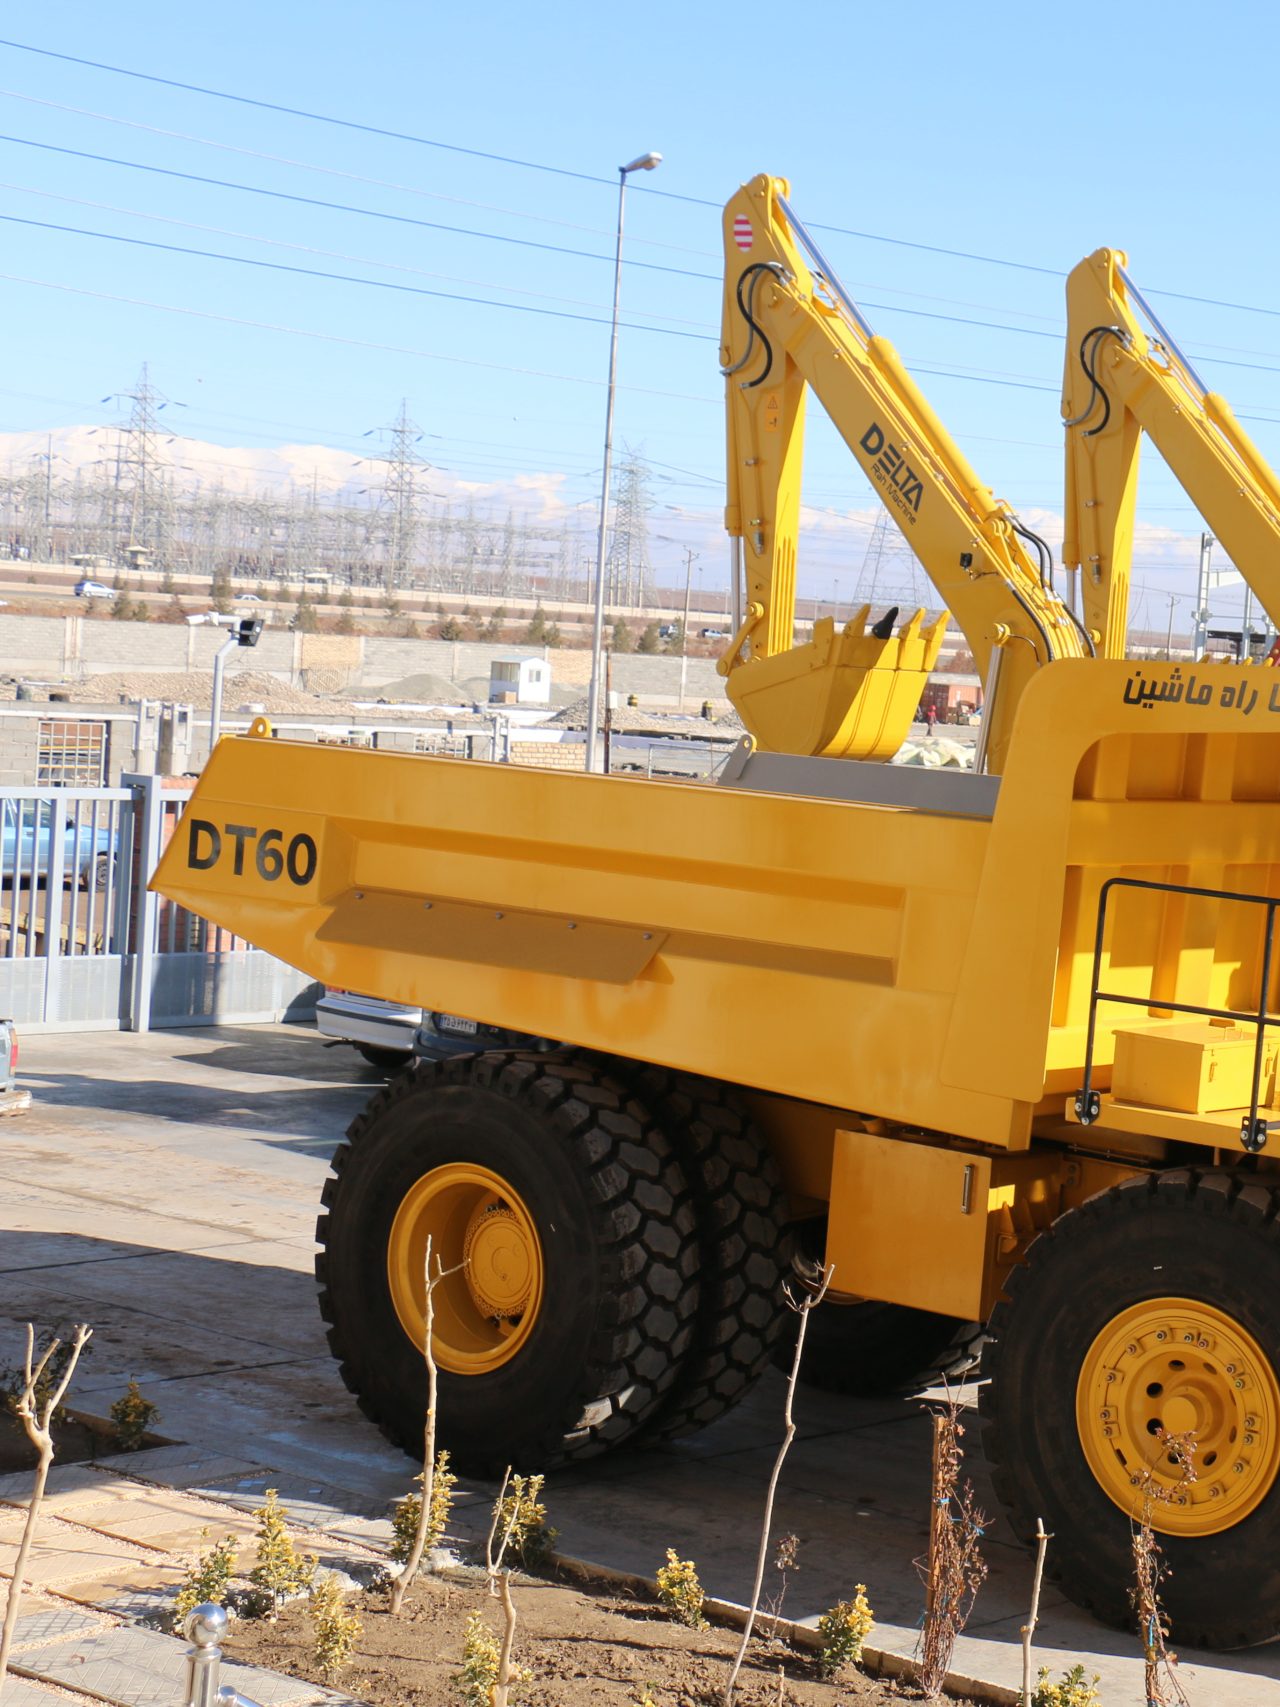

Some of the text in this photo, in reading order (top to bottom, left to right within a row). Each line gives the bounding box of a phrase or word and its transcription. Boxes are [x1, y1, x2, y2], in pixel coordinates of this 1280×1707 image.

[860, 422, 924, 513] DELTA
[871, 463, 917, 525] Rah Machine
[1123, 667, 1214, 709] ماشین
[1219, 679, 1259, 716] راه
[188, 818, 318, 886] DT60
